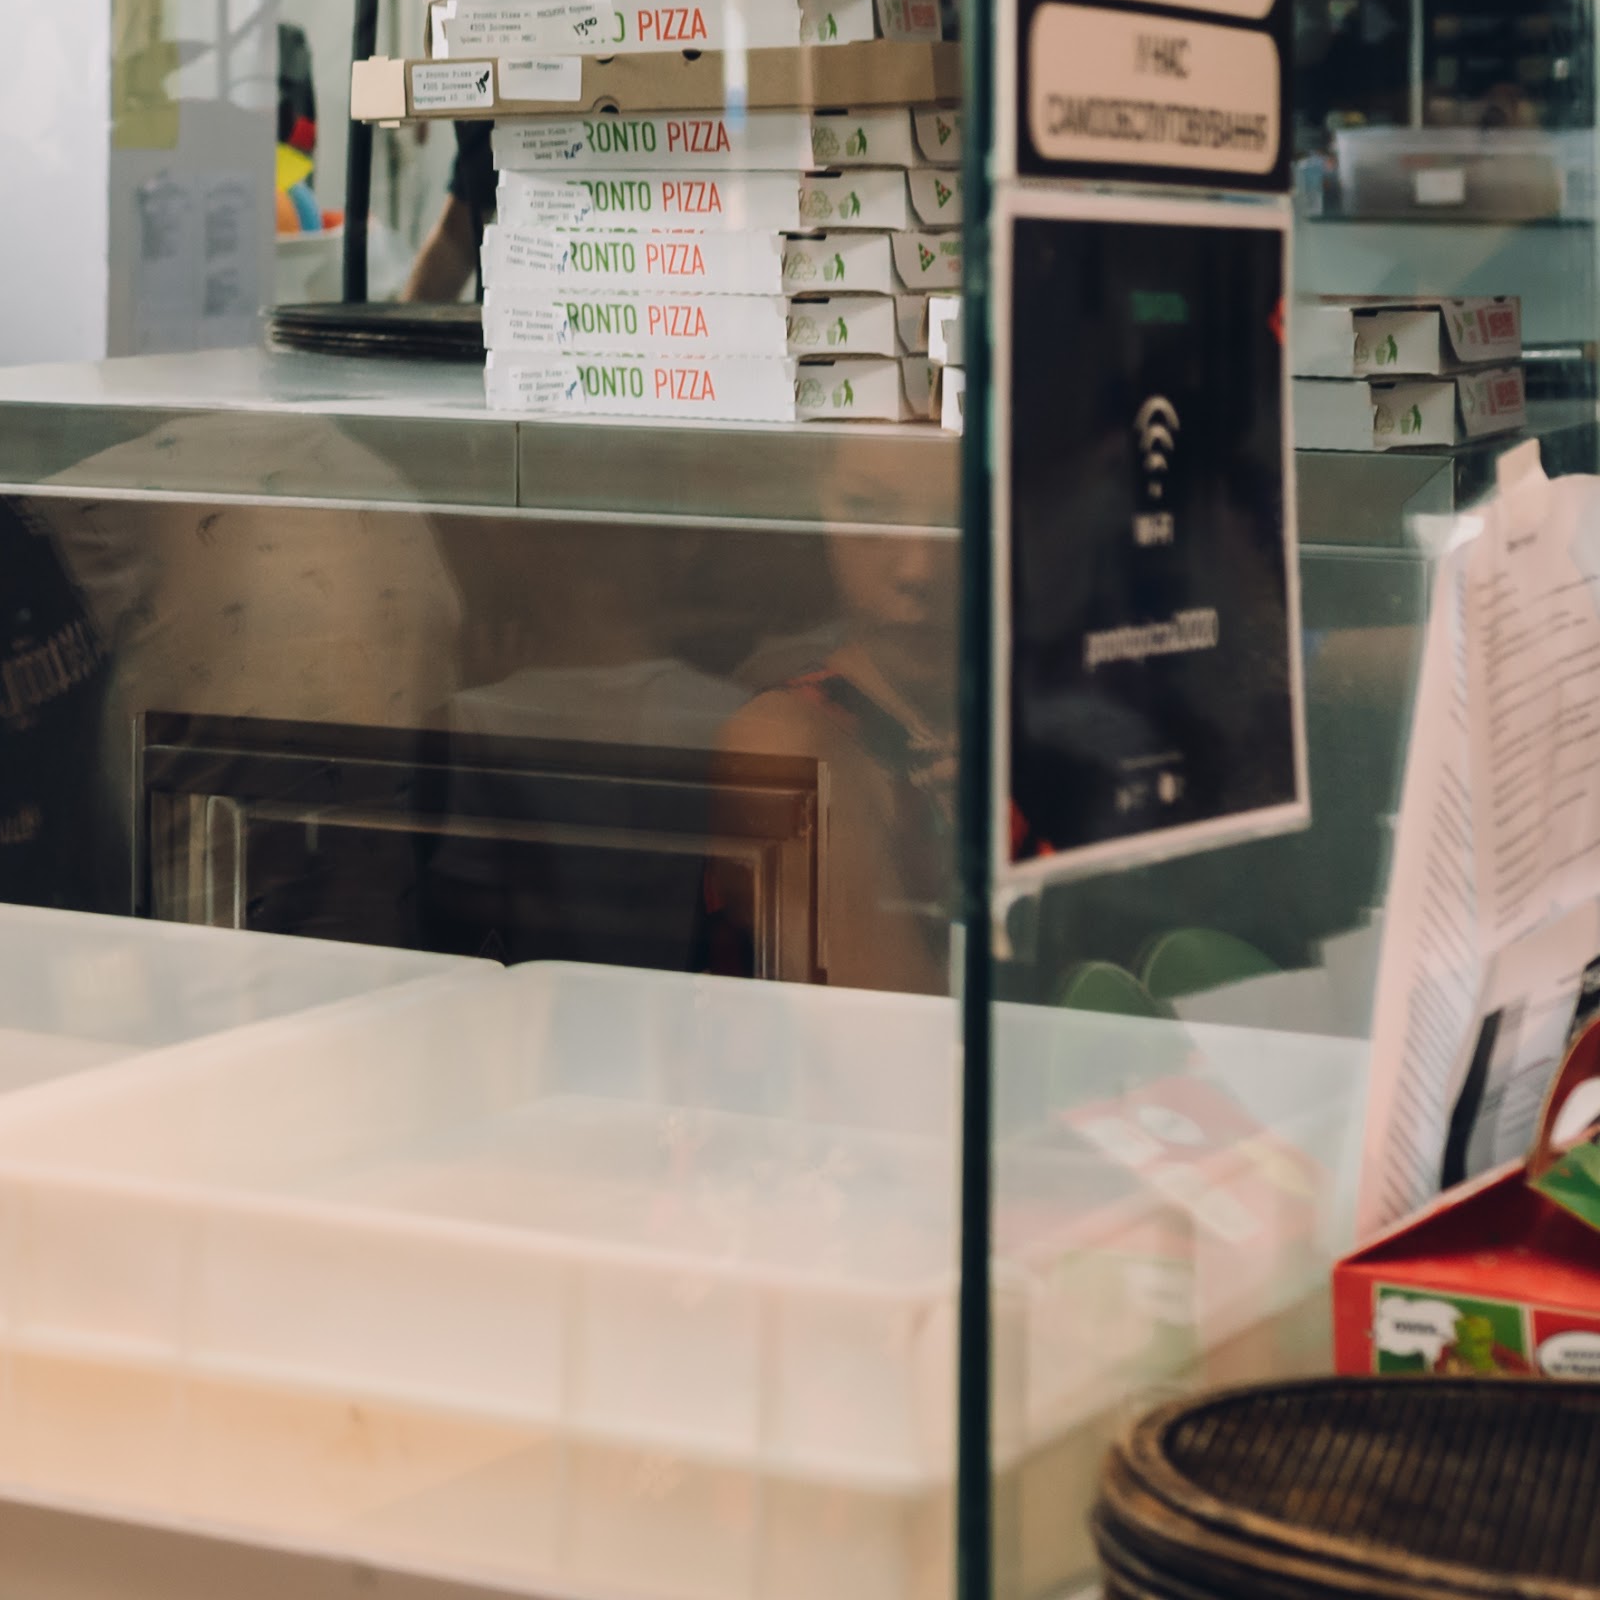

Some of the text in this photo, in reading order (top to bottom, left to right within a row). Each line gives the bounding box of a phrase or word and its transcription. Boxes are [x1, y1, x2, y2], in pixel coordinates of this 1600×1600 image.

[637, 7, 708, 42] PIZZA
[585, 120, 657, 154] RONTO
[667, 120, 731, 153] PIZZA
[661, 181, 723, 214] PIZZA
[569, 241, 636, 273] RONTO
[645, 243, 705, 276] PIZZA
[553, 302, 638, 335] RONTO
[647, 305, 709, 338] PIZZA
[654, 368, 716, 402] PIZZA
